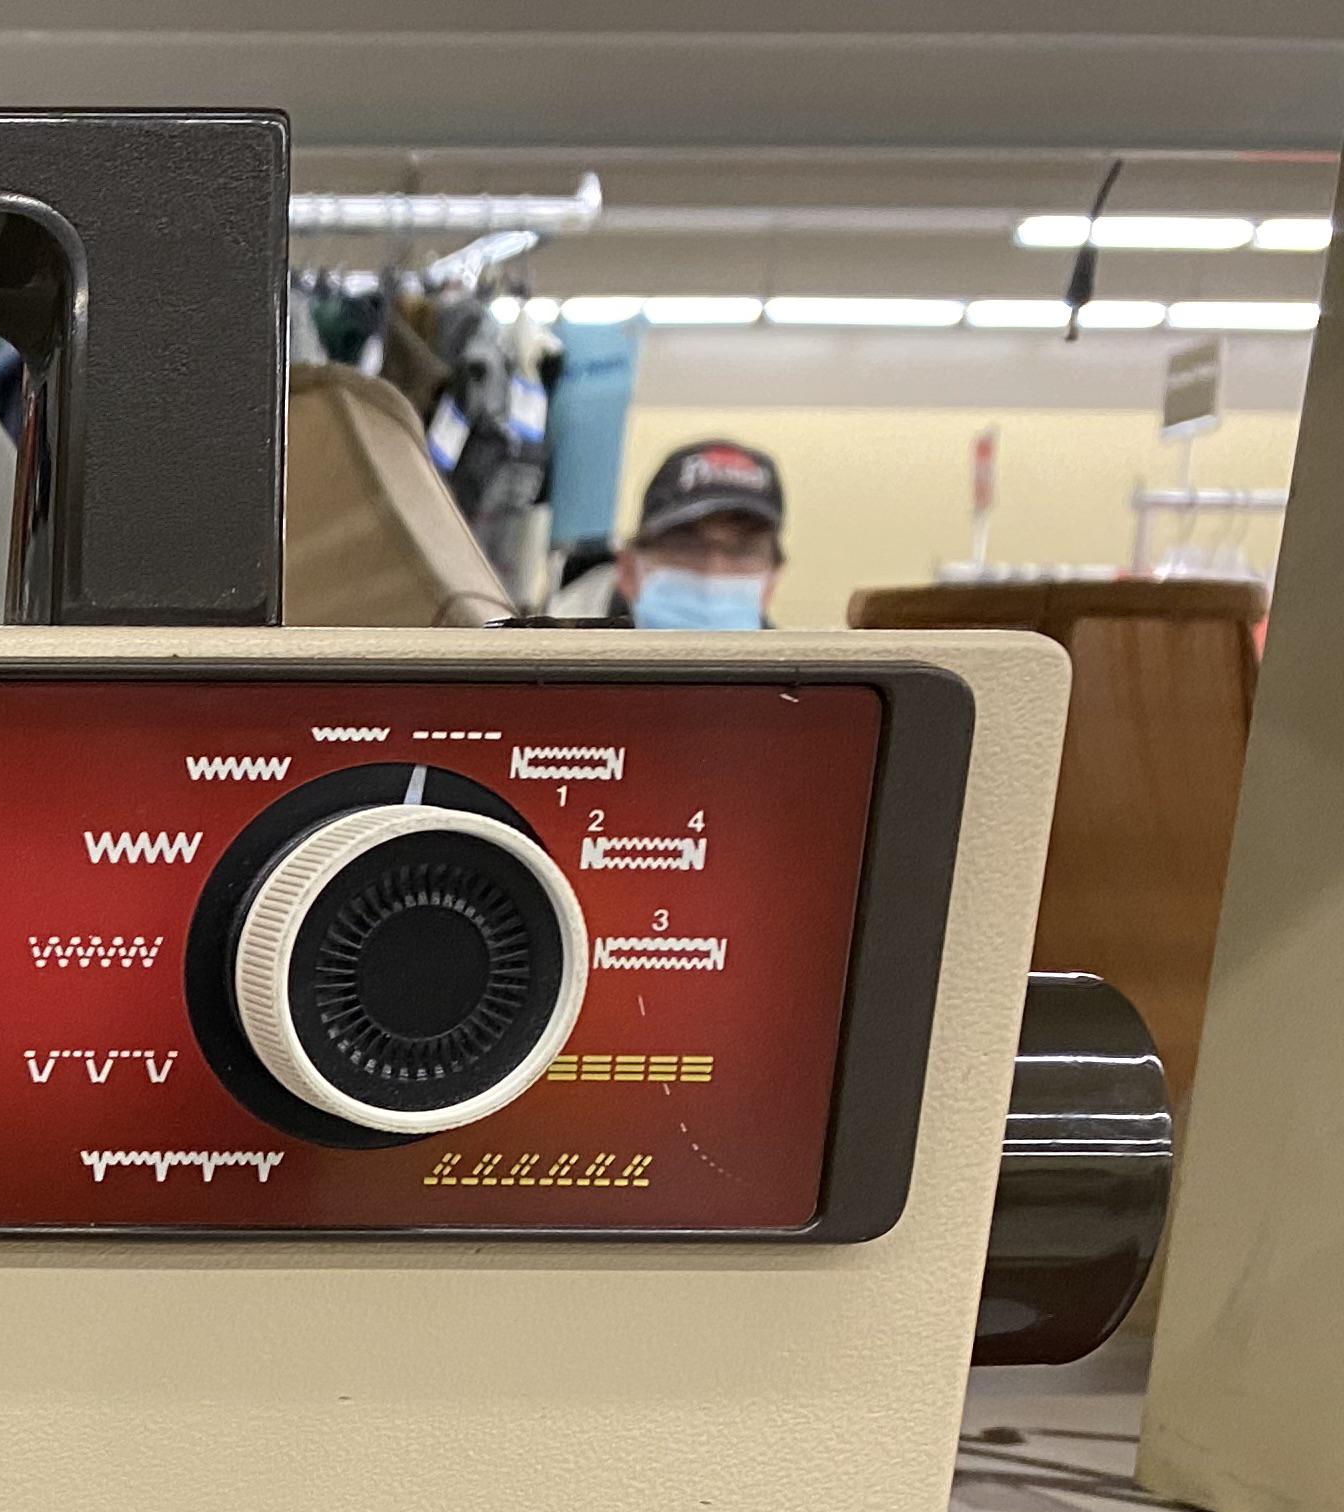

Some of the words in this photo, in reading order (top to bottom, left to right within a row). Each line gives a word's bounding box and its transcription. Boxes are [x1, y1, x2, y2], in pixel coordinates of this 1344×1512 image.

[556, 784, 569, 807] 1
[587, 809, 605, 832] 2
[687, 810, 706, 833] 4
[651, 908, 670, 932] 3
